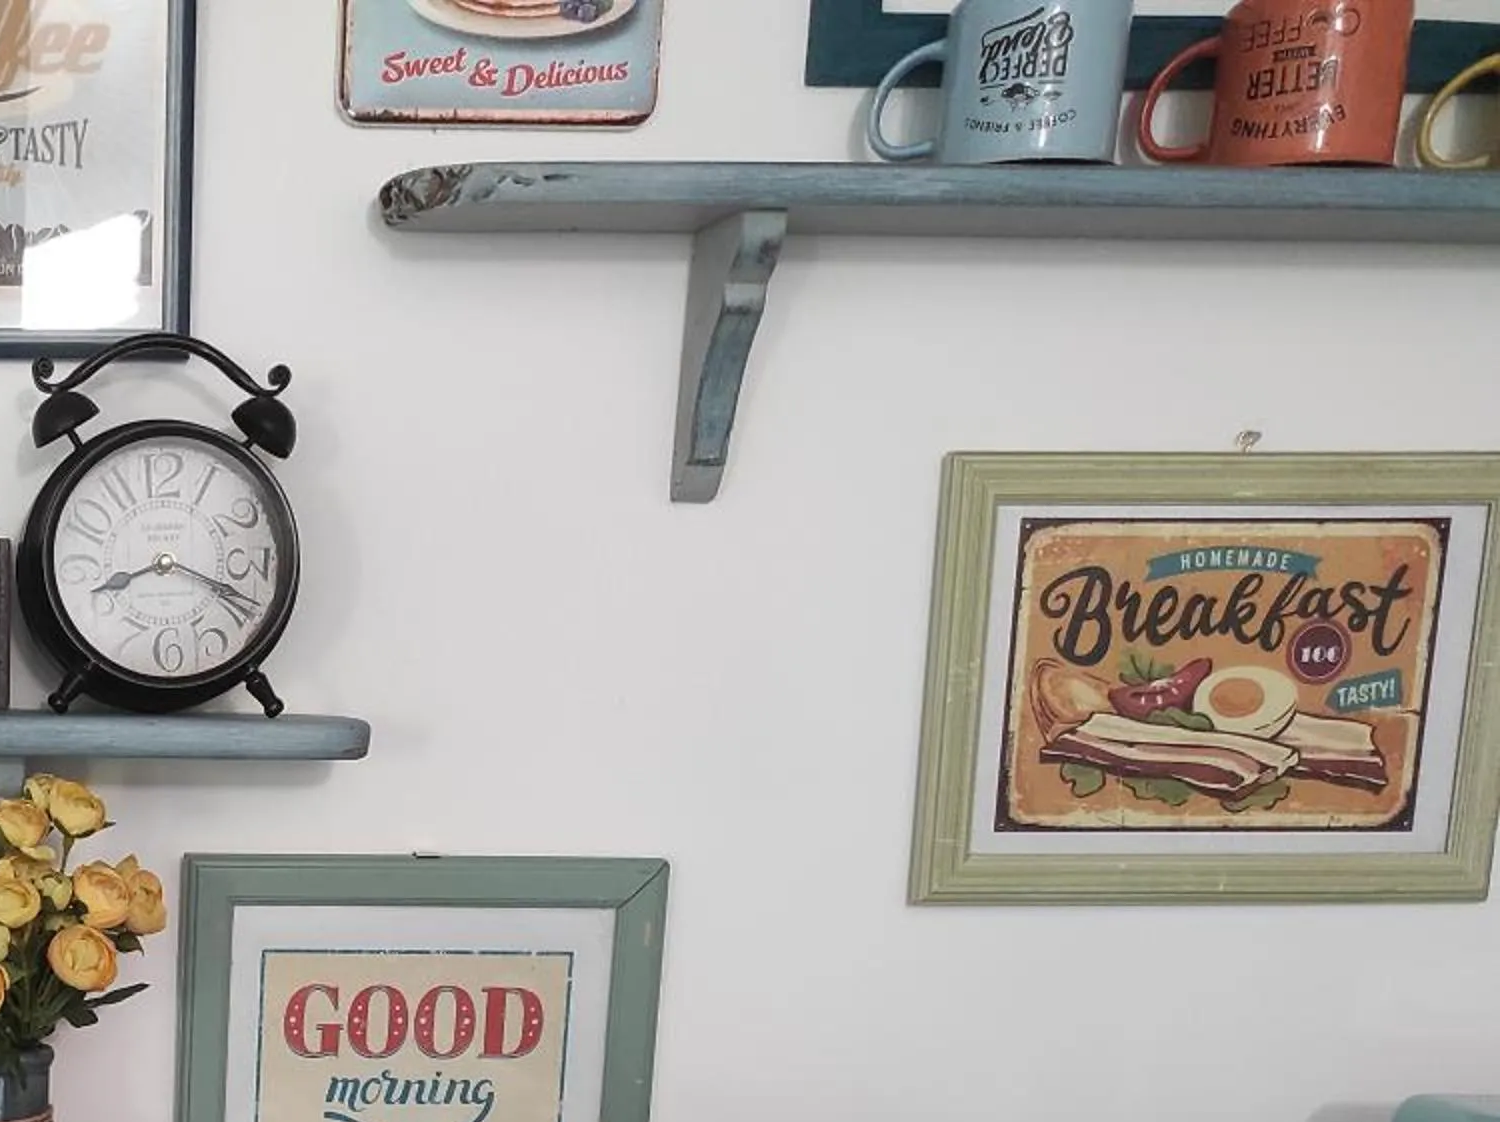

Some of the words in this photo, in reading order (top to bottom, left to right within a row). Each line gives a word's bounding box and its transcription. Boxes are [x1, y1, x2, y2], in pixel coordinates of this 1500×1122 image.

[979, 7, 1074, 72] Blend
[381, 47, 468, 84] Sweet
[468, 58, 498, 87] &
[501, 59, 629, 97] Delicious
[1247, 58, 1339, 100] BETTER
[8, 118, 90, 170] TASTY
[101, 466, 137, 512] 11
[140, 450, 184, 498] 12
[194, 464, 231, 505] 1
[63, 499, 112, 546] 10
[210, 497, 260, 538] 2
[59, 554, 100, 585] 9
[225, 547, 271, 582] 3
[1179, 551, 1292, 572] HOMEMADE
[190, 612, 230, 659] 5
[1039, 562, 1412, 667] Breakfast
[152, 627, 184, 673] 6
[1336, 677, 1396, 708] TASTY!
[283, 983, 545, 1060] GOOD
